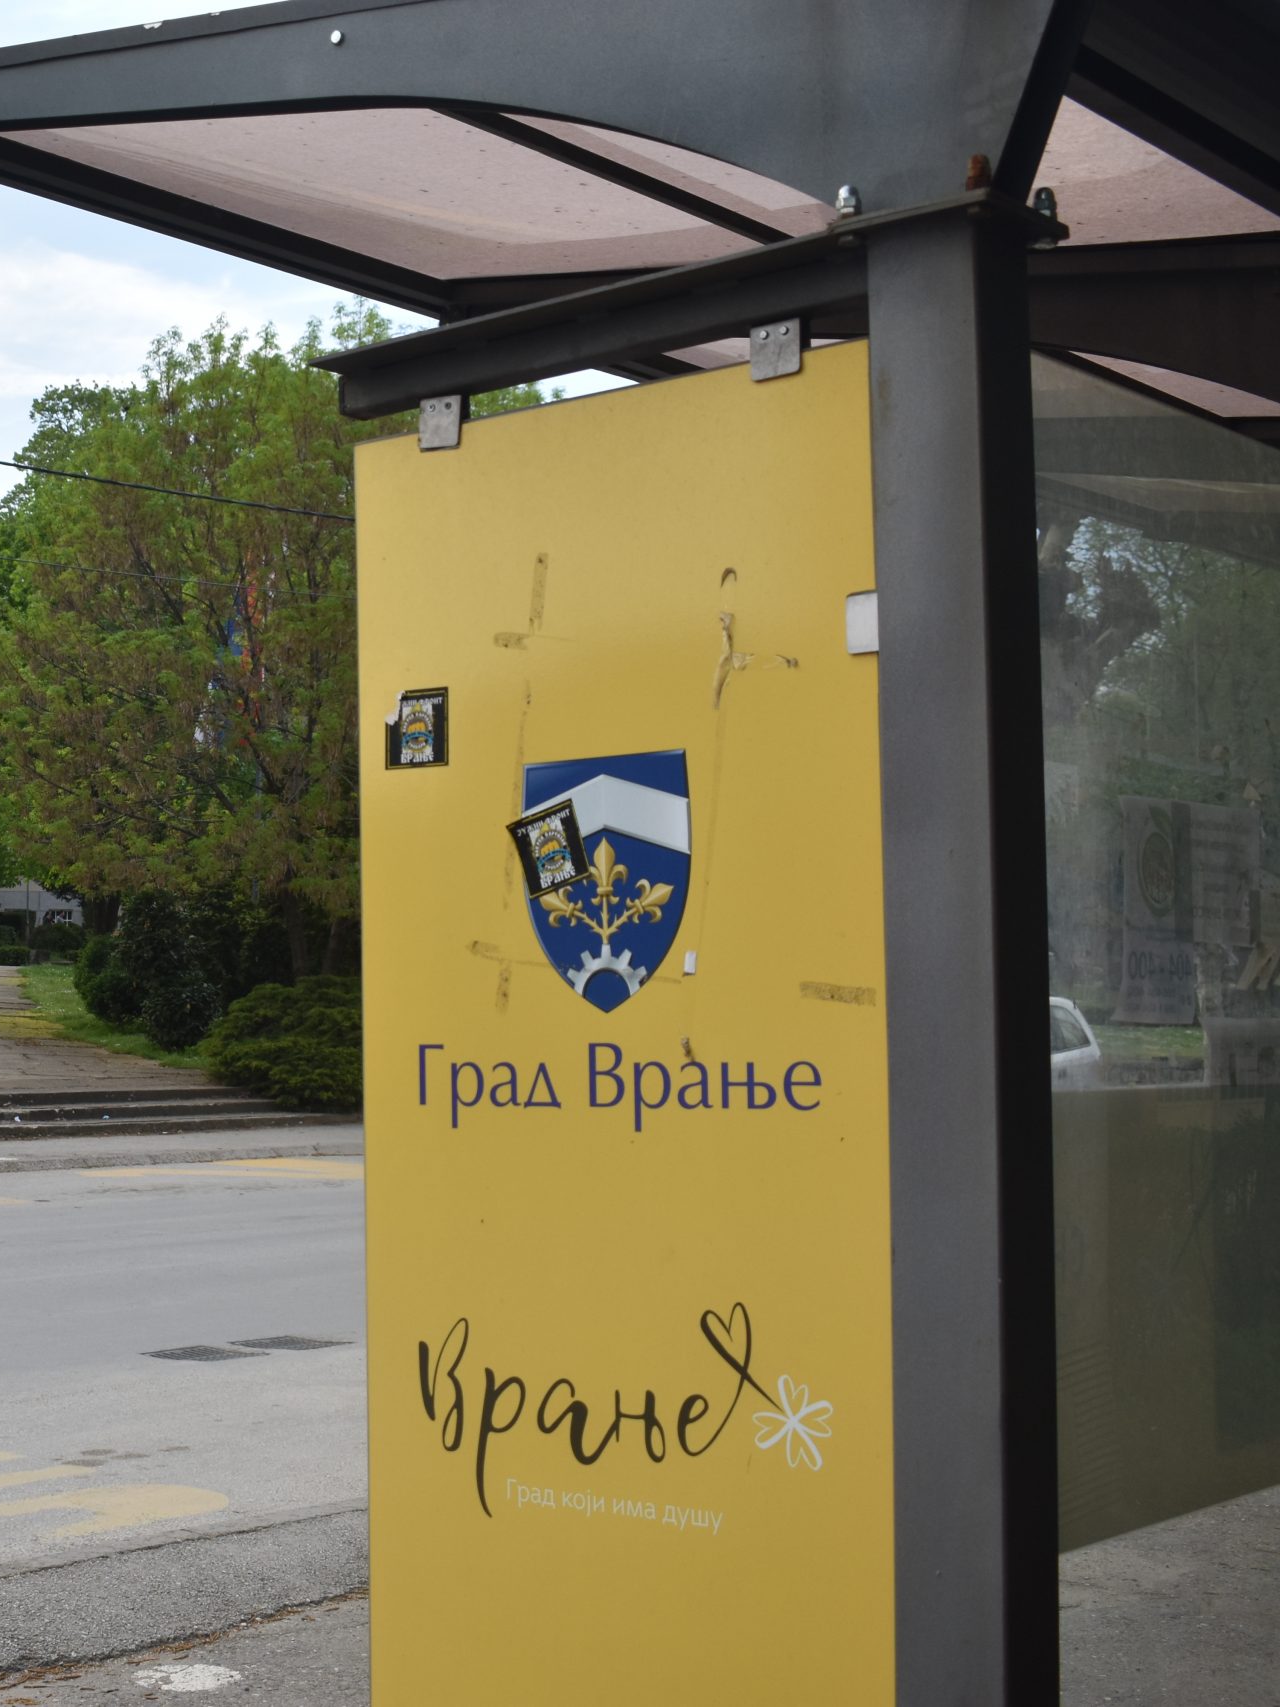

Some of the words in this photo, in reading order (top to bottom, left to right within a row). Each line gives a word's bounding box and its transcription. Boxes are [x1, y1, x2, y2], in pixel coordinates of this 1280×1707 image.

[417, 1044, 562, 1129] Град
[587, 1042, 823, 1132] Врање
[418, 1302, 784, 1518] Врање
[506, 1478, 555, 1511] Град
[562, 1489, 606, 1518] који
[612, 1496, 657, 1520] има
[662, 1505, 724, 1535] душу
